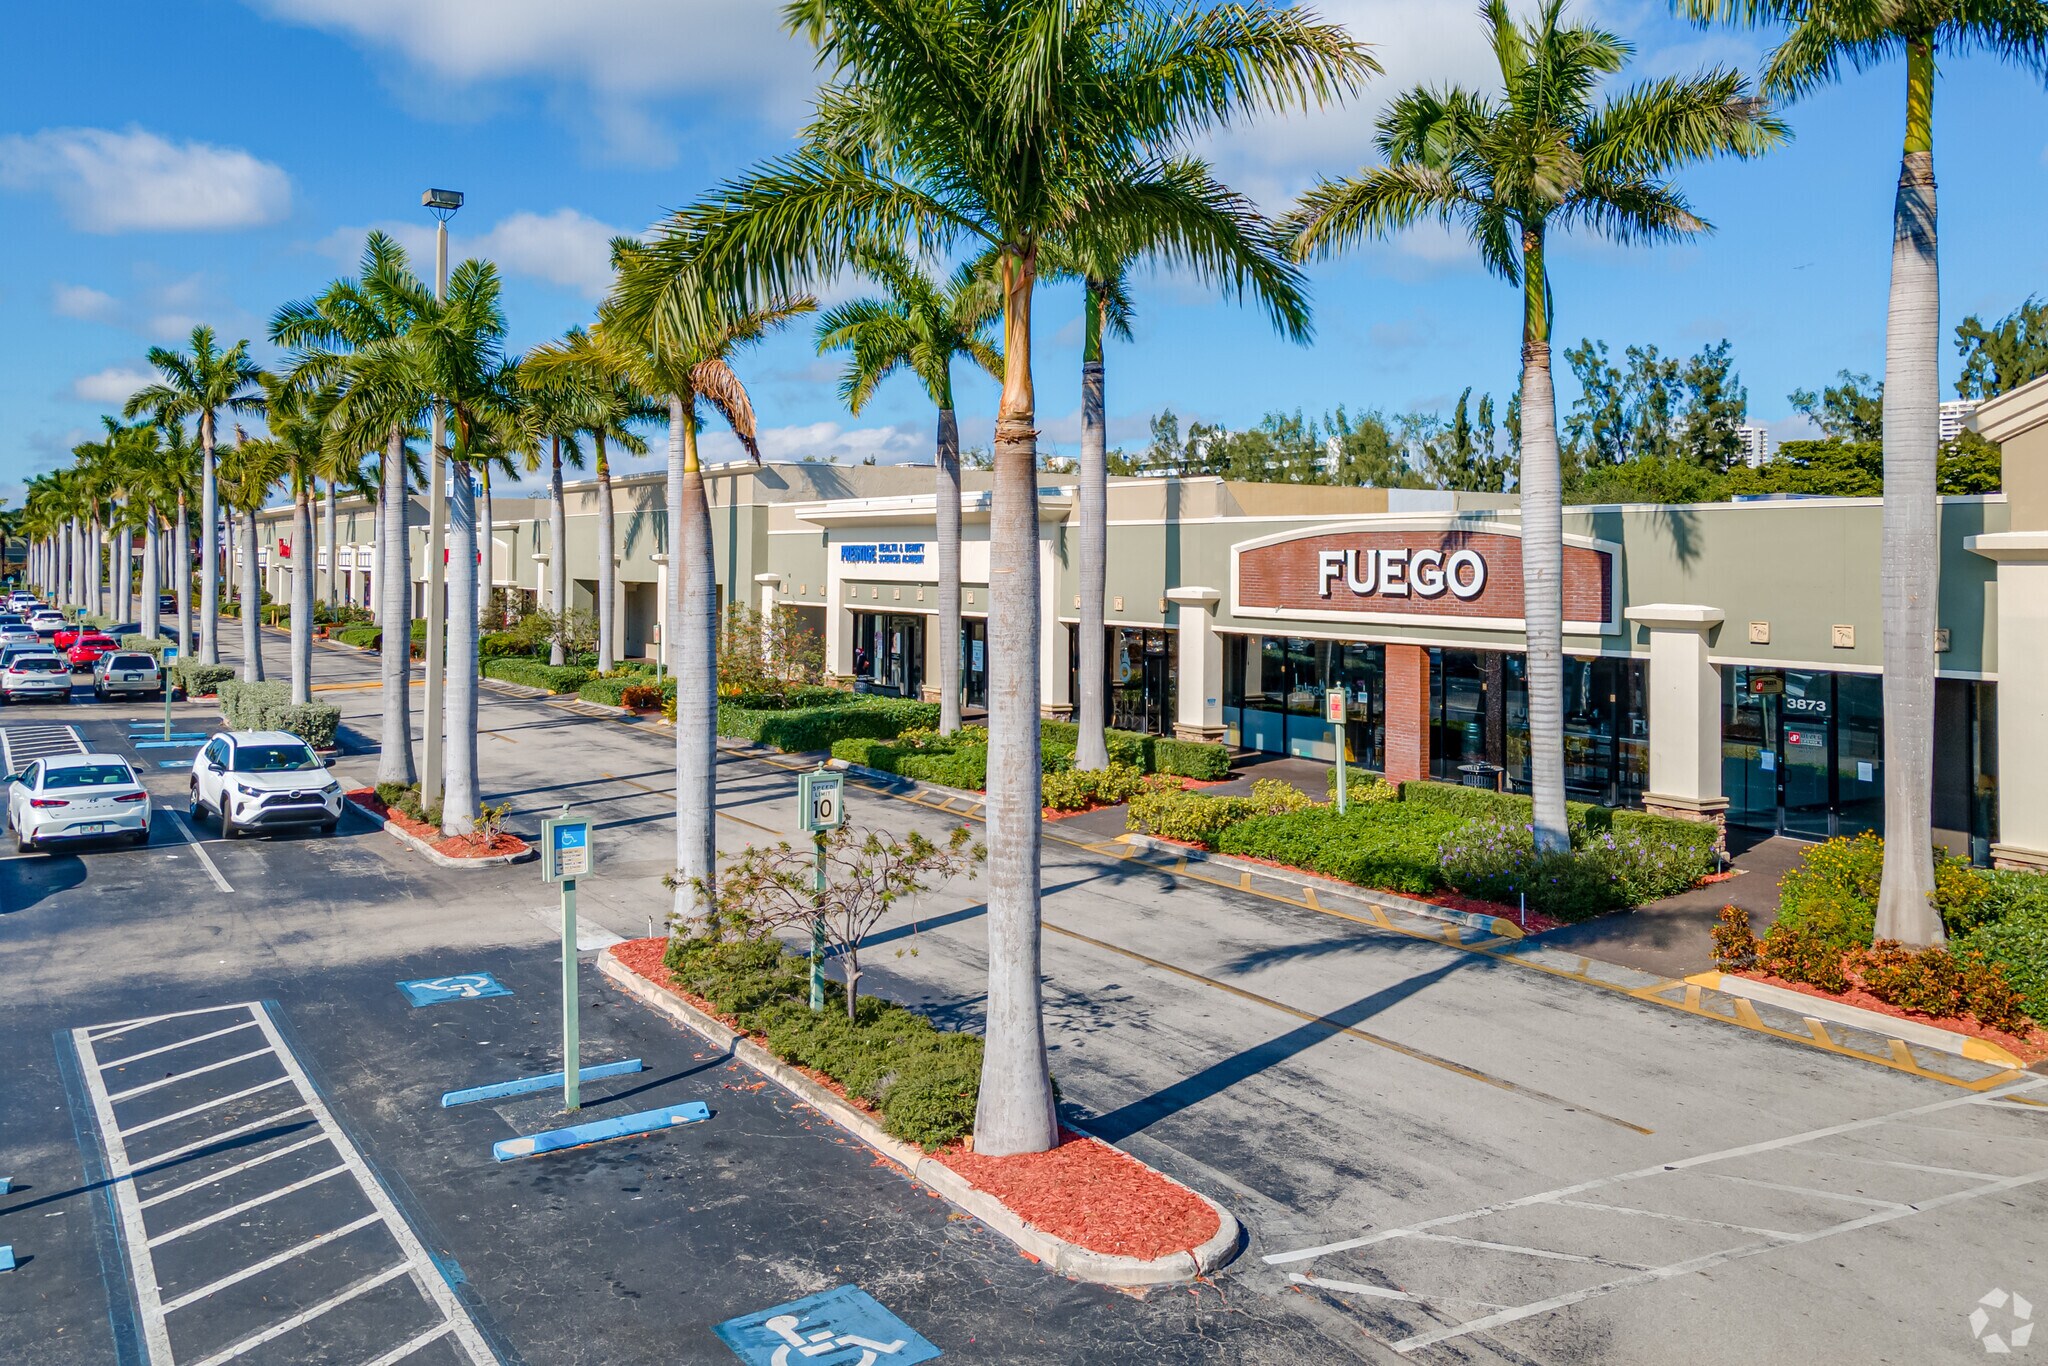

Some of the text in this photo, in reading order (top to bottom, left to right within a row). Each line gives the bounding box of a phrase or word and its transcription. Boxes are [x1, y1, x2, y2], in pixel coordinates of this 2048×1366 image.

[841, 545, 877, 563] PRESTIGE
[1318, 548, 1488, 602] FUEGO
[1787, 698, 1827, 712] 3873
[814, 790, 831, 798] LIMIT
[813, 799, 832, 819] 10
